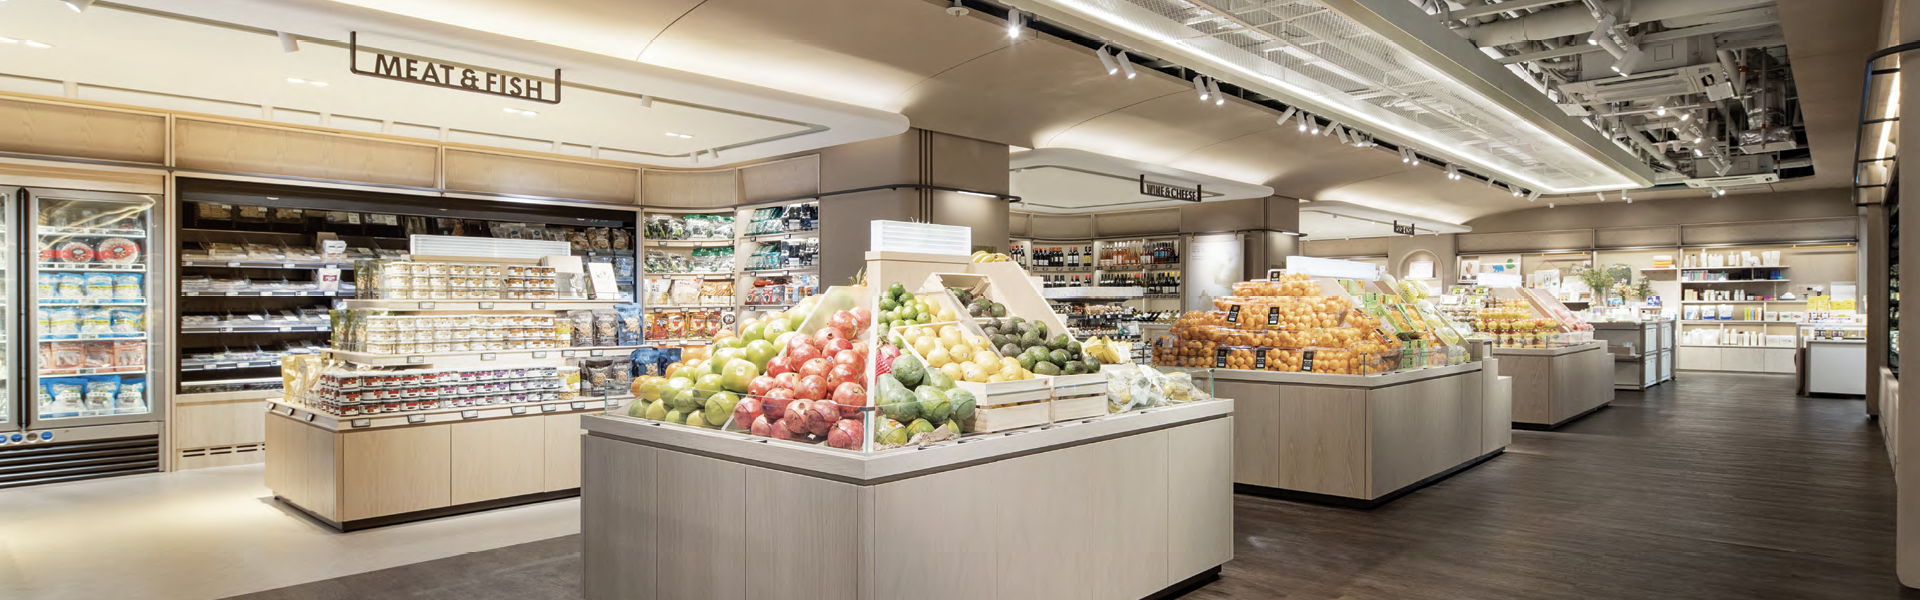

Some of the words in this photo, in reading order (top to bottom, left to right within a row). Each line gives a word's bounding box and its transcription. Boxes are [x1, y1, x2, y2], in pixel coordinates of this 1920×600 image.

[374, 53, 455, 84] MEAT
[460, 68, 479, 90] &
[486, 72, 542, 100] FISH
